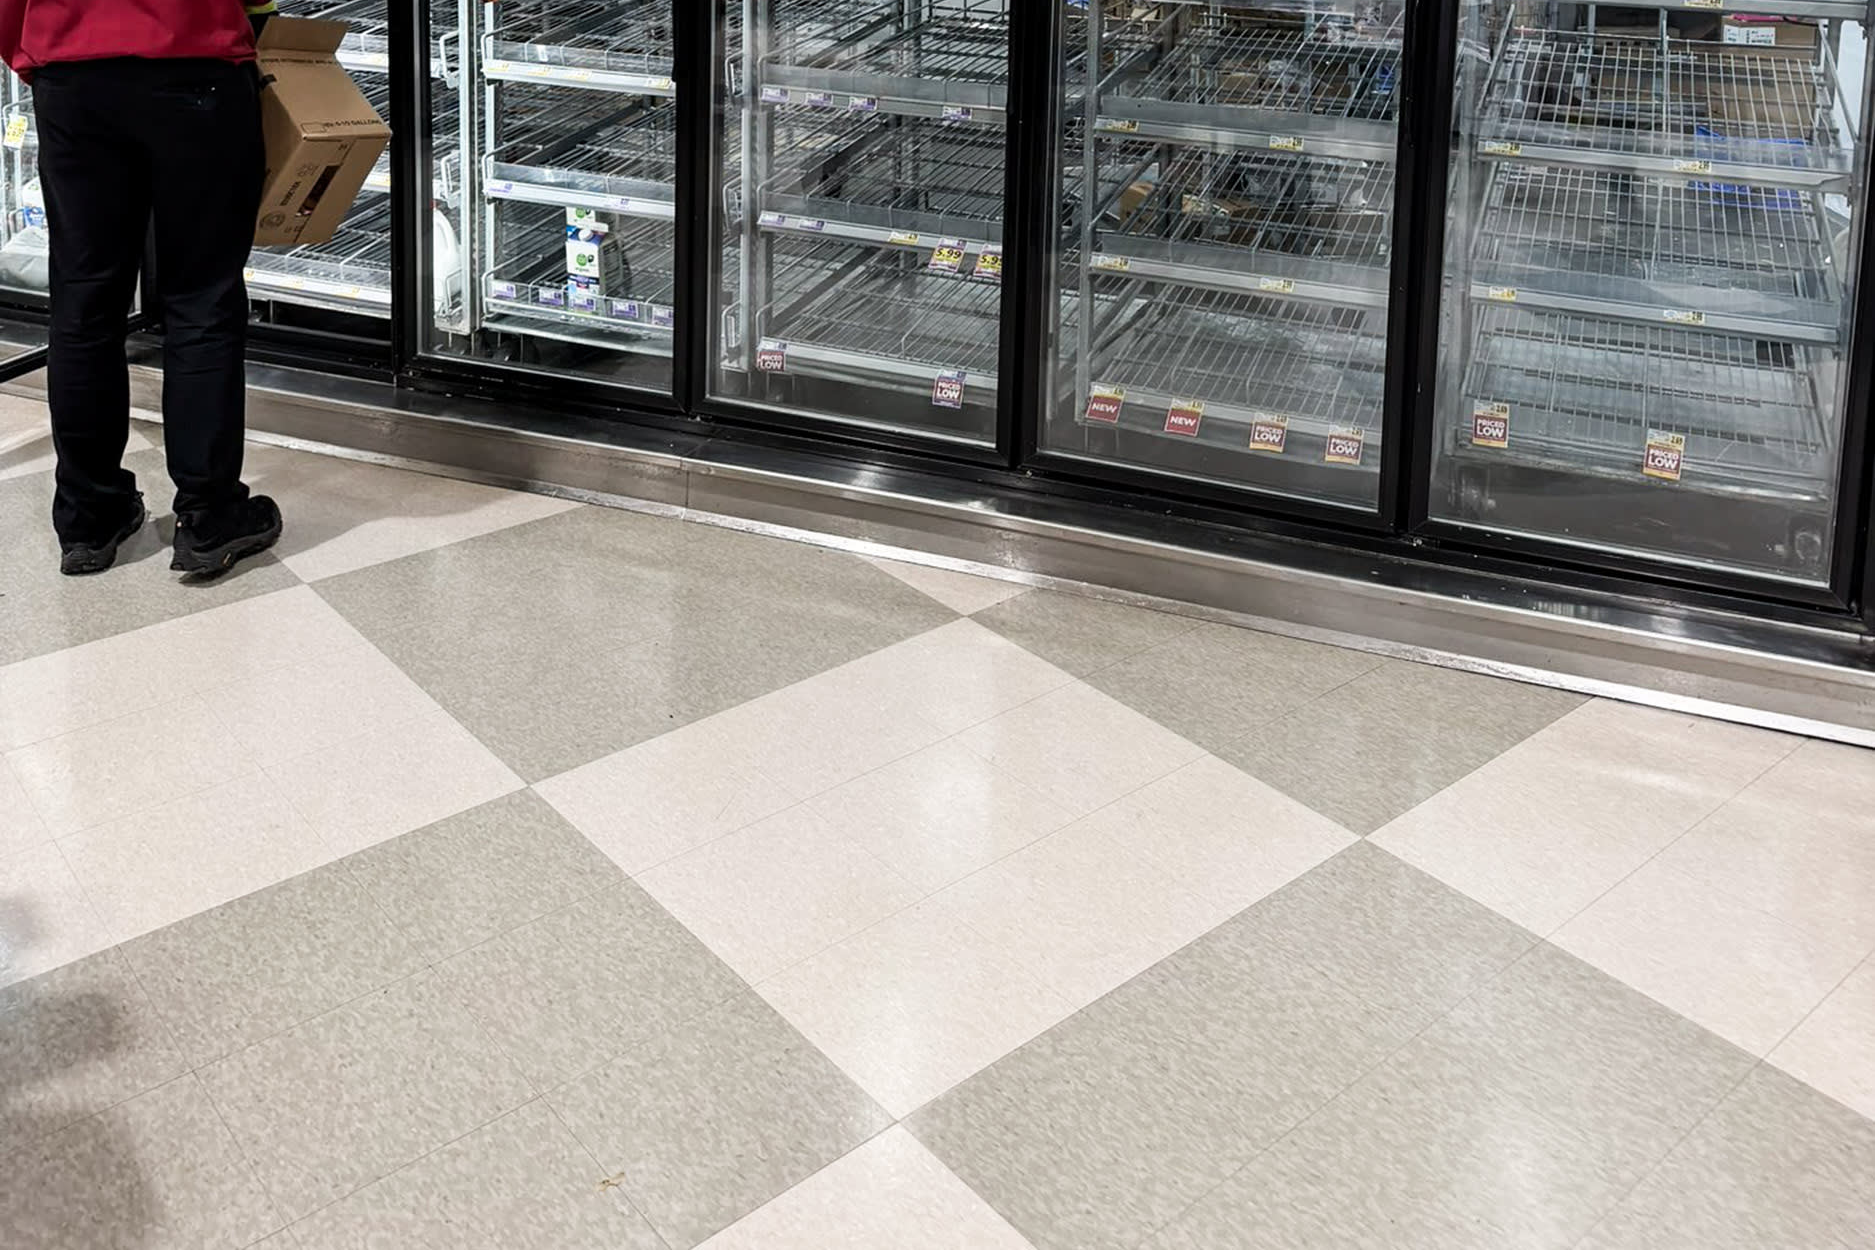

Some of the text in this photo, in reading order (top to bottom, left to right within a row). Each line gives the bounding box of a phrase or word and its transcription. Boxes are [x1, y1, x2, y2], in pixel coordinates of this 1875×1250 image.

[935, 247, 962, 259] 5.99
[760, 360, 783, 370] LOW
[936, 388, 960, 399] LOW
[1091, 402, 1117, 414] NEW
[1170, 415, 1196, 427] NEW
[1477, 419, 1505, 428] PRICED
[1256, 425, 1283, 435] PRICED
[1477, 425, 1505, 438] LOW
[1255, 431, 1282, 443] LOW
[1331, 438, 1360, 448] PRICED
[1330, 444, 1358, 456] LOW
[1649, 448, 1679, 460] PRICED
[1648, 455, 1678, 470] LOW
